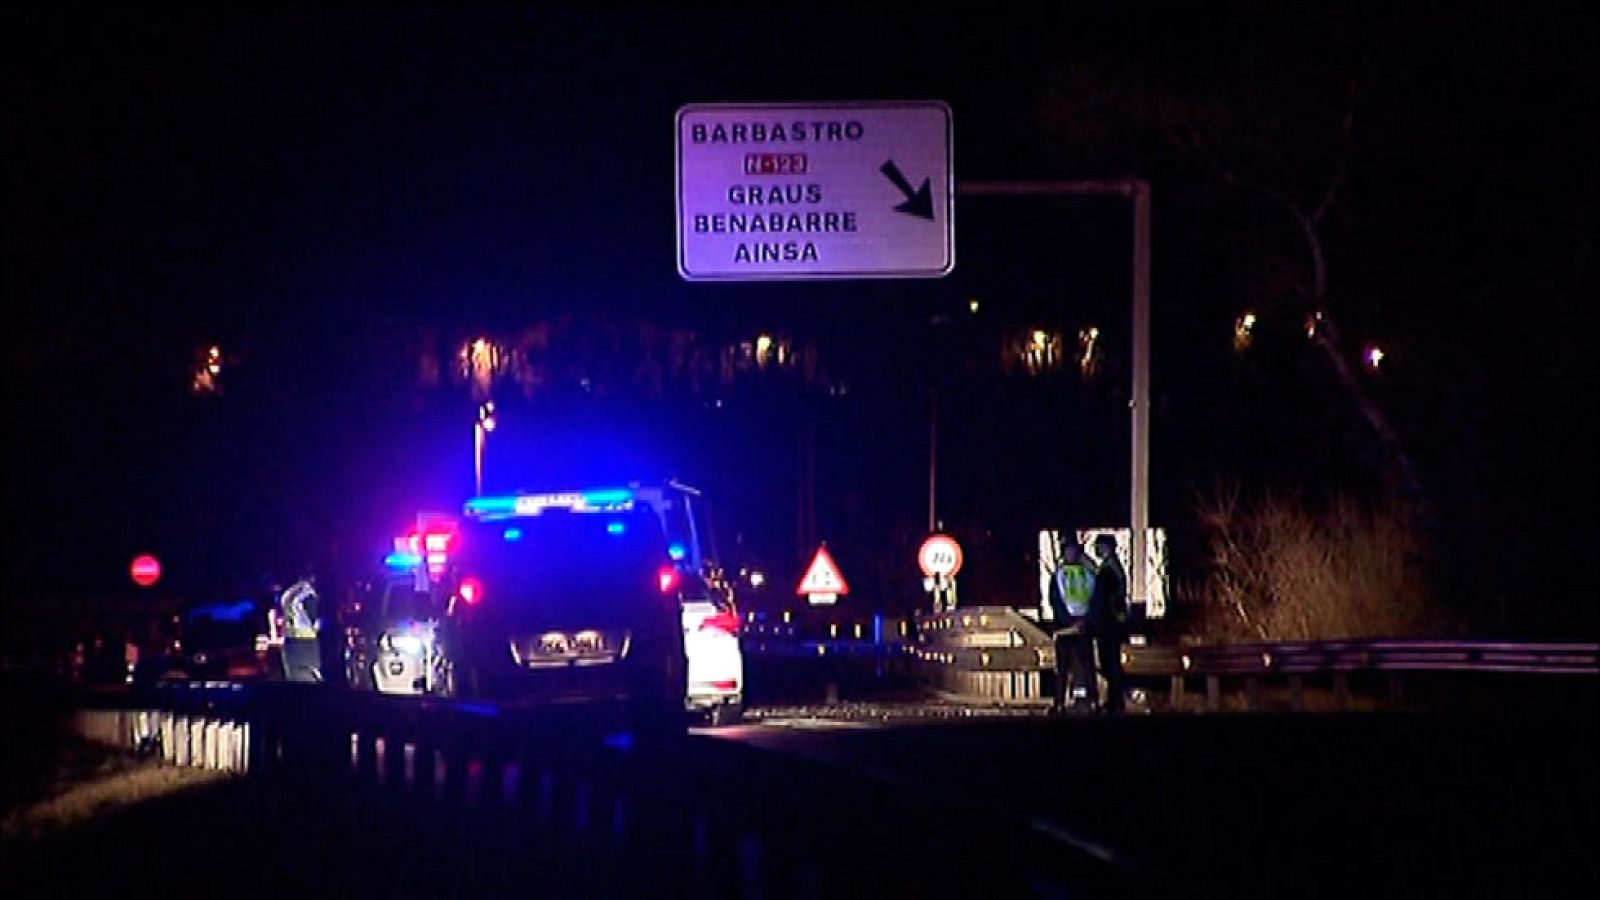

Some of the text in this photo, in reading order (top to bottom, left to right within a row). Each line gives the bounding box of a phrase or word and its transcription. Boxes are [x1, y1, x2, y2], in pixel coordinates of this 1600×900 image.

[691, 121, 865, 143] BARBASTRO
[728, 184, 822, 204] GRAUS
[694, 212, 857, 232] BENABARRE
[734, 242, 819, 263] AINSA
